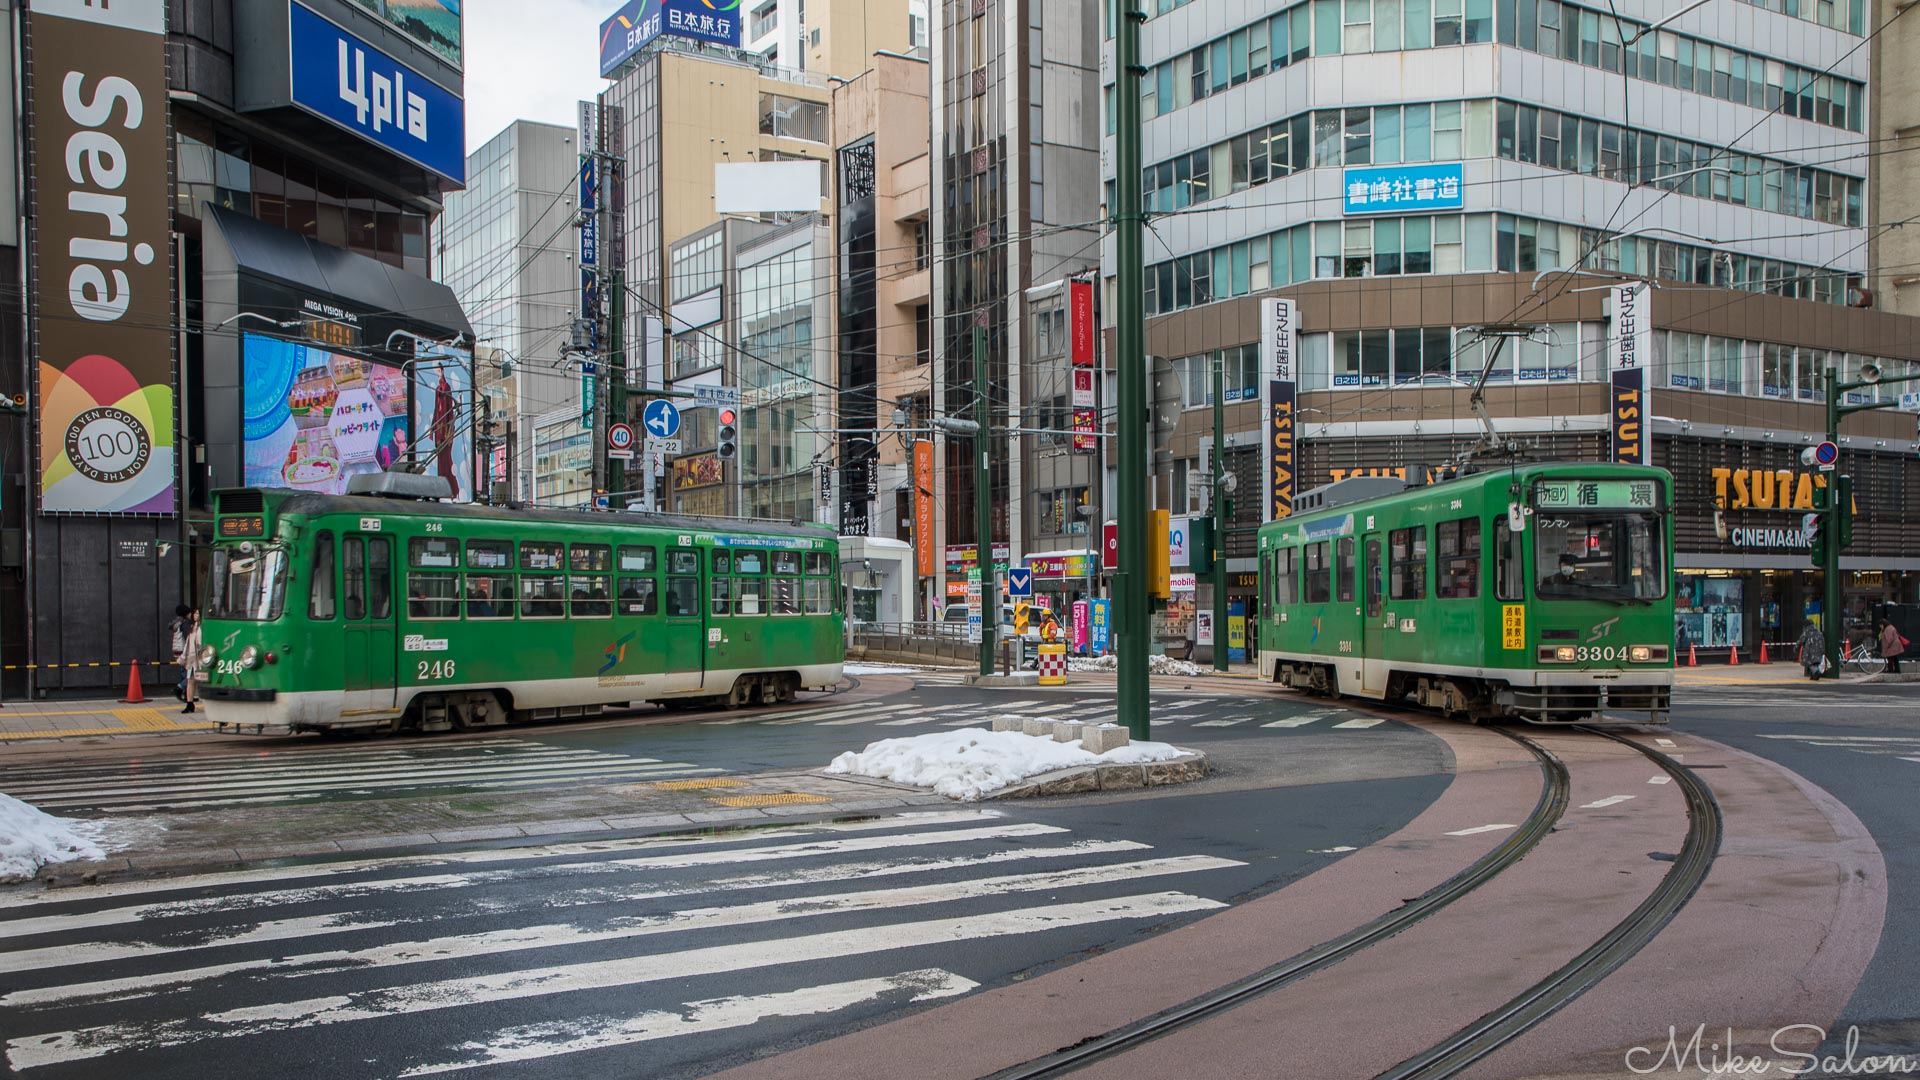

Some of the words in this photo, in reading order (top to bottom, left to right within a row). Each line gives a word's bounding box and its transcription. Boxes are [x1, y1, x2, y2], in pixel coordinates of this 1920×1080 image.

[626, 13, 660, 51] 日本旅行
[670, 8, 731, 35] 日本旅行
[670, 24, 690, 32] NIPPON
[690, 26, 710, 36] TRAVEL
[710, 31, 731, 39] AGENCY
[338, 38, 427, 142] 4pla
[62, 70, 155, 321] Seria
[1348, 176, 1459, 205] 書峰社書道
[304, 300, 322, 312] MEGA
[322, 304, 344, 318] VISION
[1276, 302, 1288, 380] 日之出歯科
[1620, 287, 1636, 368] 日之出歯科
[68, 426, 80, 444] 100
[78, 410, 100, 425] YEN
[105, 410, 142, 434] GOODS
[614, 430, 628, 444] 40
[1618, 388, 1638, 464] TSUT
[82, 430, 134, 460] 100
[126, 442, 148, 474] COLOR
[72, 454, 98, 478] DAYS
[1274, 401, 1292, 520] TSUTAYA
[104, 472, 126, 481] THE
[1712, 468, 1858, 515] TSUTA
[426, 523, 442, 532] 246
[1540, 519, 1570, 528] ワンマン
[1032, 560, 1049, 574] ビッグ
[1170, 578, 1195, 586] mobile
[217, 660, 242, 674] 246
[1577, 646, 1628, 661] 3304
[418, 660, 455, 680] 246
